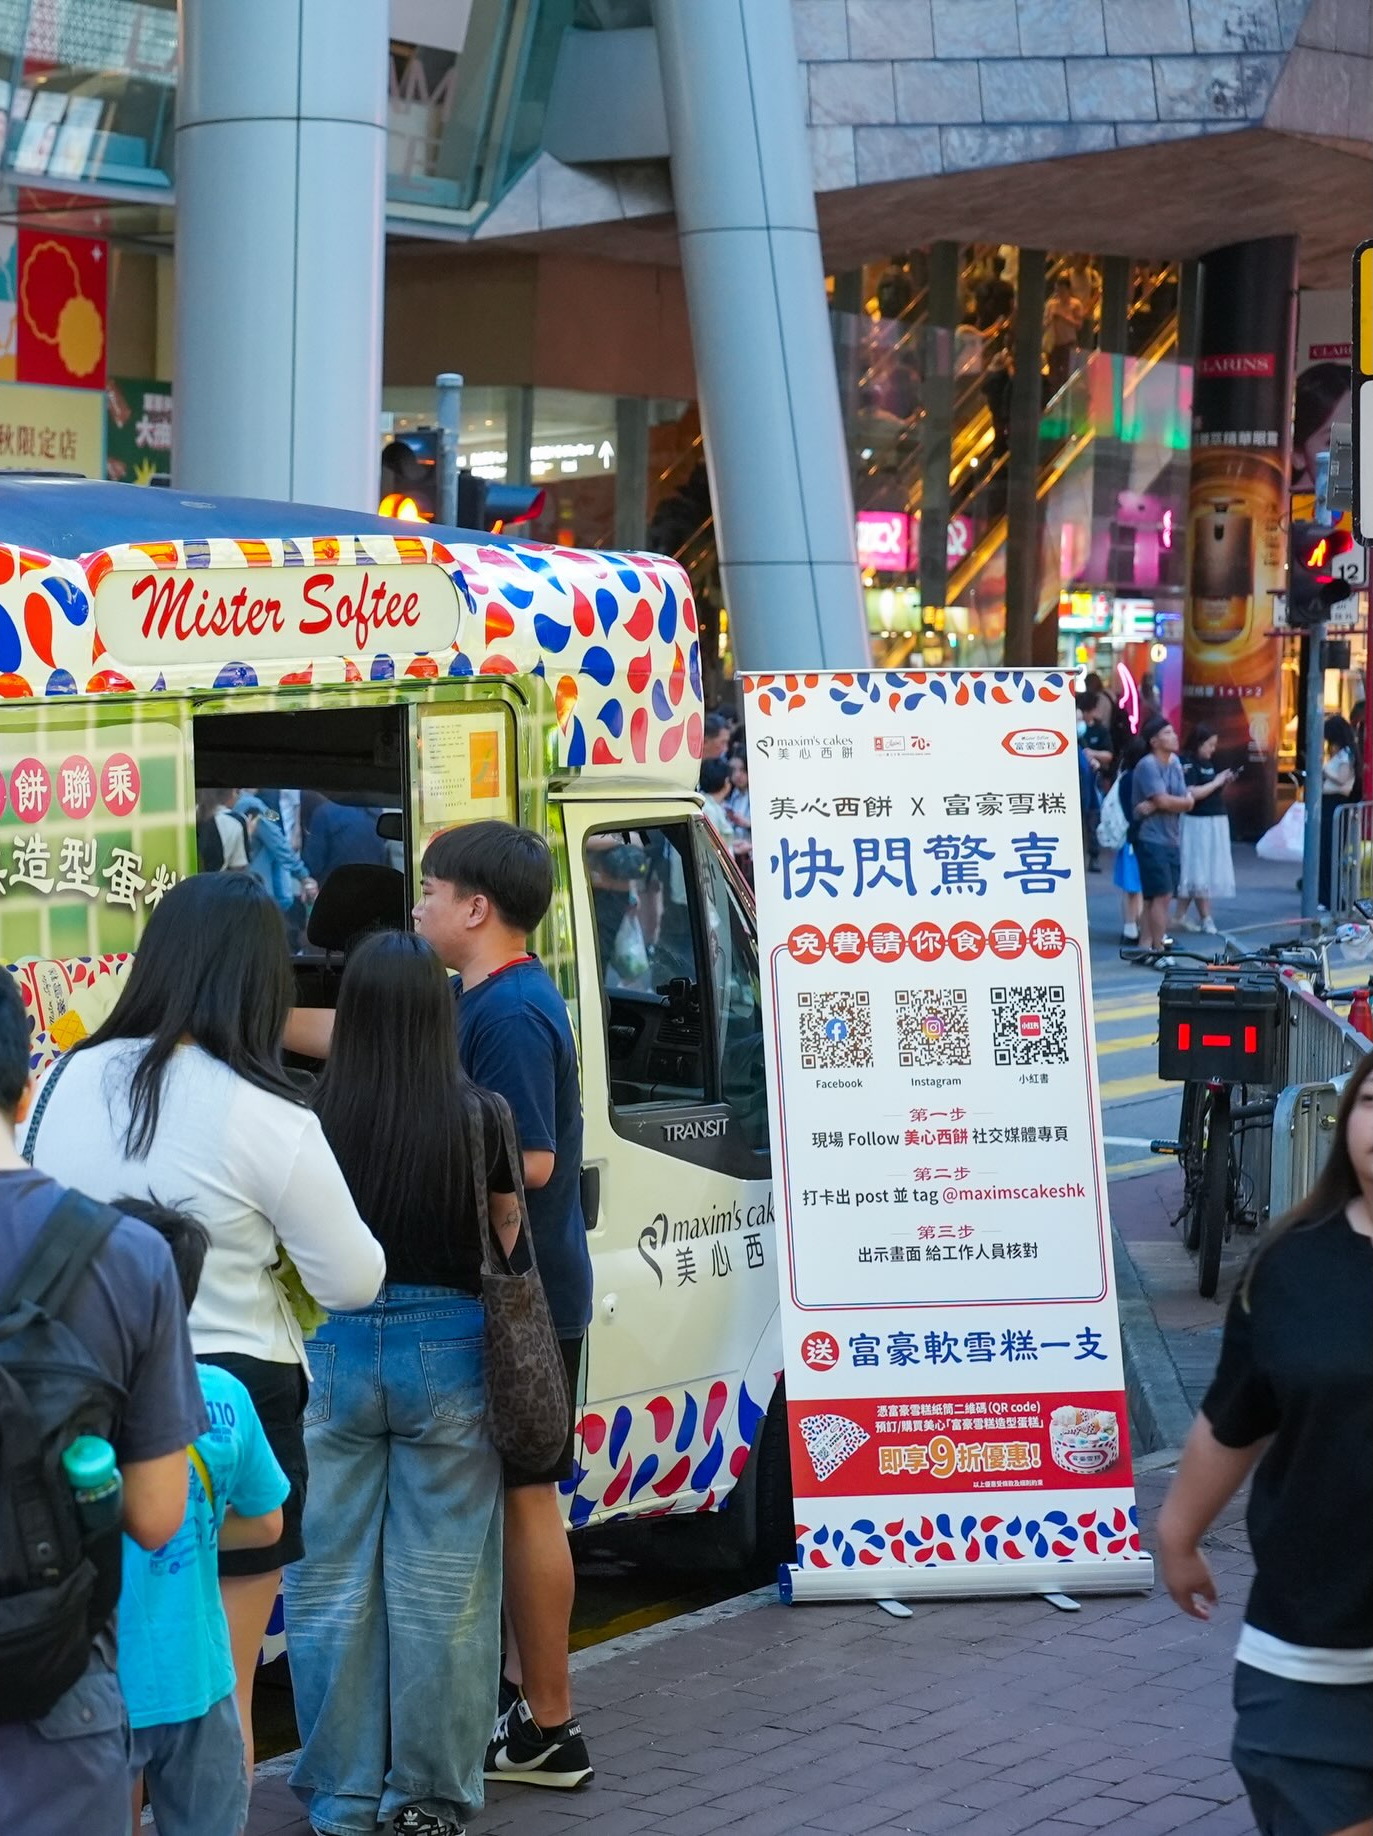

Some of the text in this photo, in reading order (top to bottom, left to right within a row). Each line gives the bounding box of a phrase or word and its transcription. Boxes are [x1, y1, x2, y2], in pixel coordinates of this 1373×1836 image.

[131, 571, 421, 650] Mister Softee
[778, 735, 853, 746] maxim's cakes
[768, 796, 893, 820] 美心西餅
[943, 791, 1067, 817] 富豪雪糕
[770, 831, 1072, 900] 快閃驚喜
[791, 926, 1065, 956] 免費請你食雪糕
[816, 1077, 863, 1089] Facebook
[911, 1076, 962, 1088] Instagram
[1018, 1073, 1049, 1085] 小紅書
[909, 1107, 967, 1122] 第一步
[663, 1117, 729, 1142] TRANSIT
[812, 1126, 1068, 1148] 現場 Follow 美心西餅 社交媒體專頁
[913, 1166, 970, 1181] 第二步
[803, 1183, 1086, 1207] 打卡出 post 並 tag @maximscakeshk
[673, 1201, 741, 1243] maxim's
[917, 1225, 975, 1240] 第三步
[676, 1233, 764, 1288] 美心西
[858, 1242, 1038, 1263] 出示畫面 給工作人員核對
[806, 1337, 837, 1365] 送
[848, 1326, 1108, 1367] 富豪軟雪糕一支
[879, 1435, 1042, 1479] 即享9折優惠!
